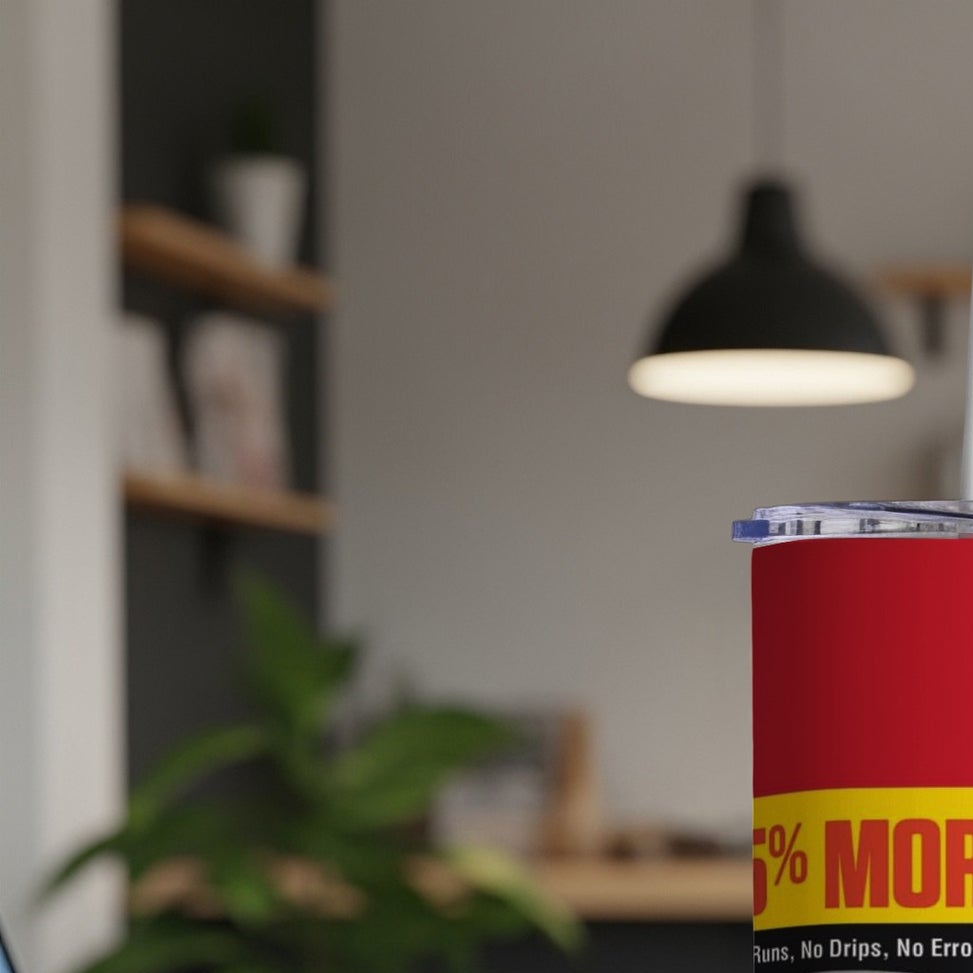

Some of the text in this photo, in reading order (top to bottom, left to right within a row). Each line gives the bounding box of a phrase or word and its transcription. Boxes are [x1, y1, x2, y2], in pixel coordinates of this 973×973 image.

[753, 945, 795, 964] Runs,
[801, 940, 823, 959] No
[830, 938, 889, 961] Drips,
[897, 938, 924, 957] No
